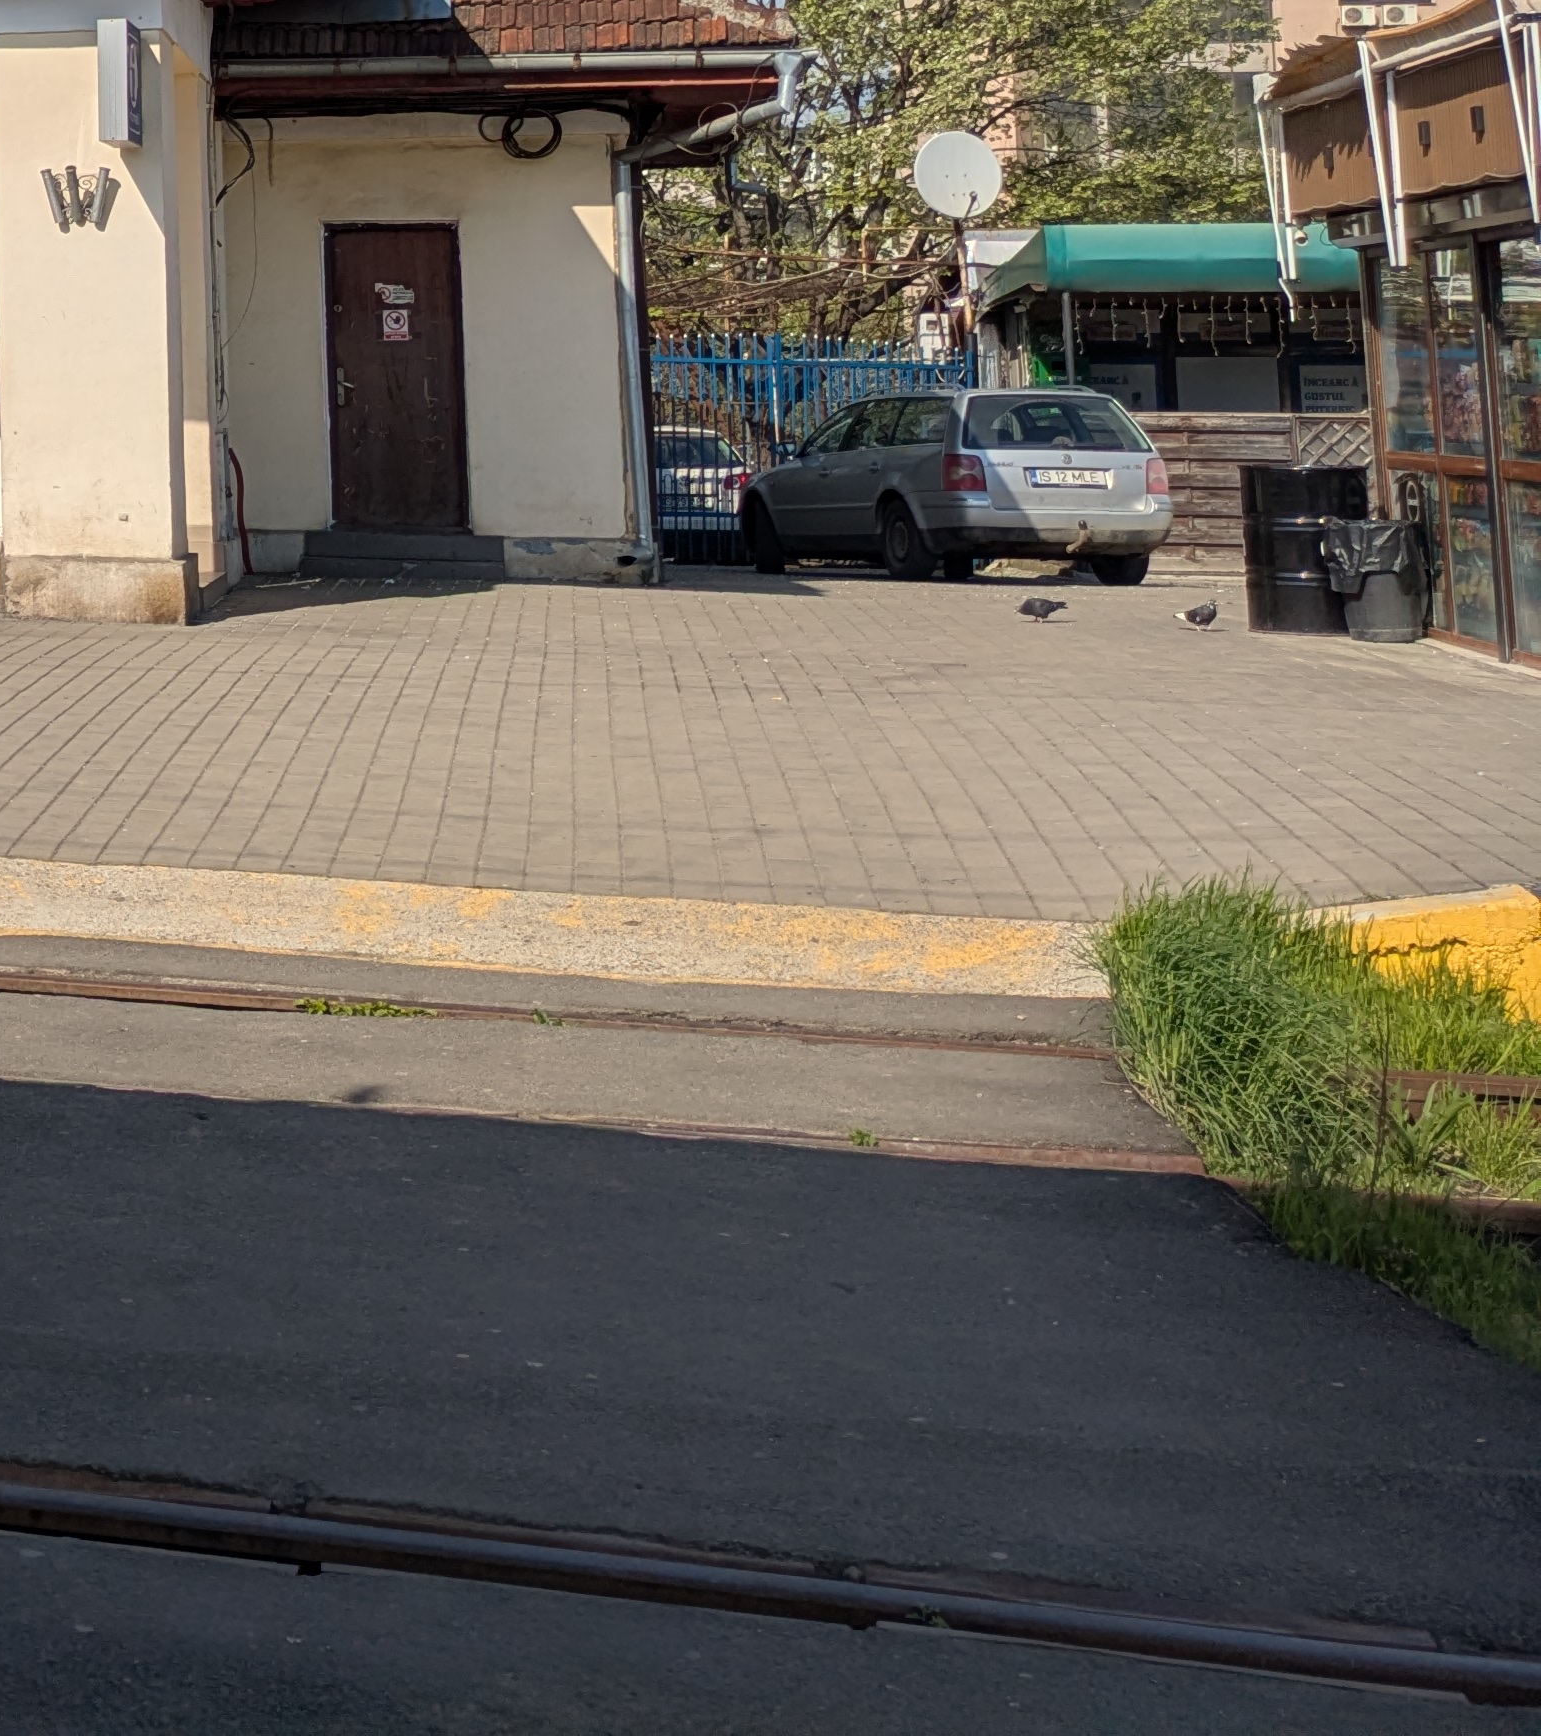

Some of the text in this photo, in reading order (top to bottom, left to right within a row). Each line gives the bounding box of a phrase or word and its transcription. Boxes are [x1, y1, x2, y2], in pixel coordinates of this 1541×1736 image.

[1039, 471, 1100, 484] IS 12 MLE
